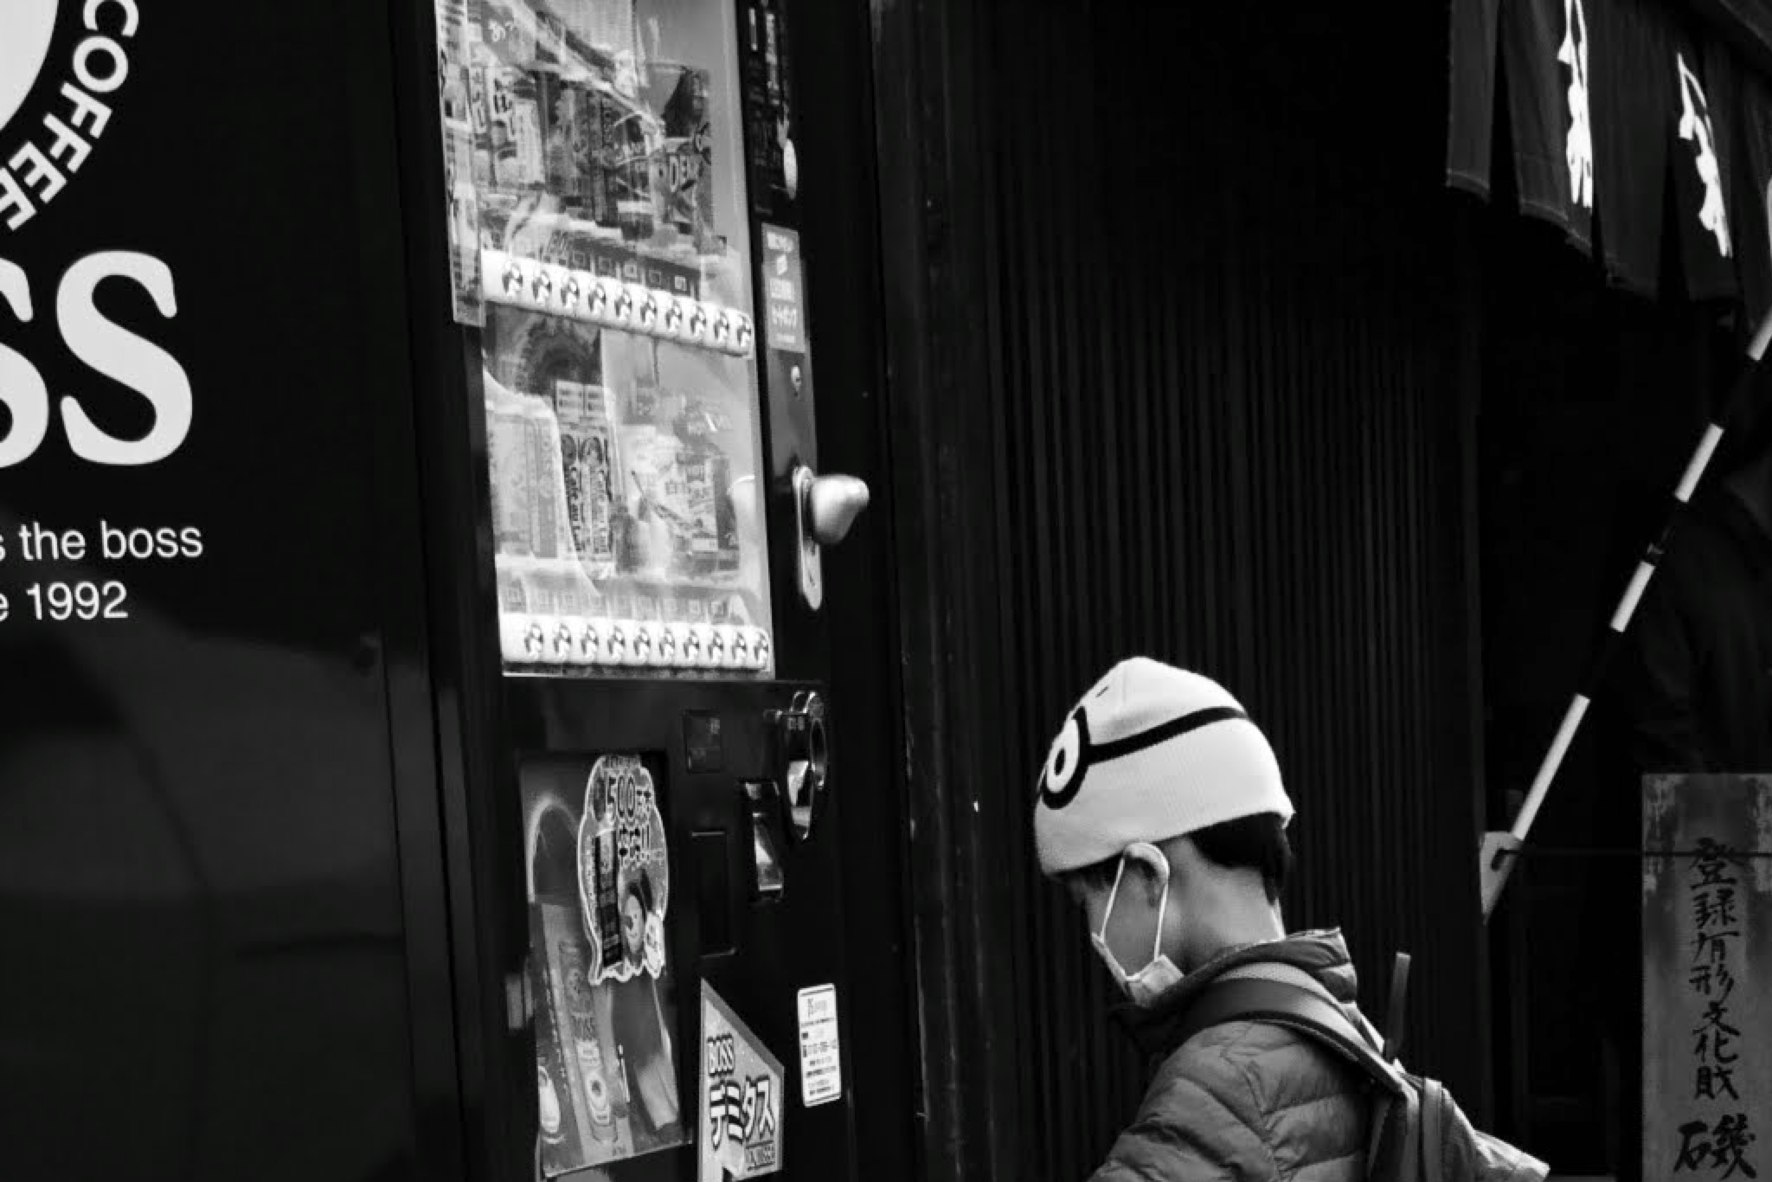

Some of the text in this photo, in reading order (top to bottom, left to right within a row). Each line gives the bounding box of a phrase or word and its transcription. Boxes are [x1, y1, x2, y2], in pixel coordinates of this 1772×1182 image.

[0, 0, 139, 231] COFFEE
[18, 521, 86, 561] the
[101, 520, 204, 559] boss
[26, 580, 129, 621] 1992
[707, 1033, 735, 1077] BOSS
[709, 1074, 774, 1150] デミタス
